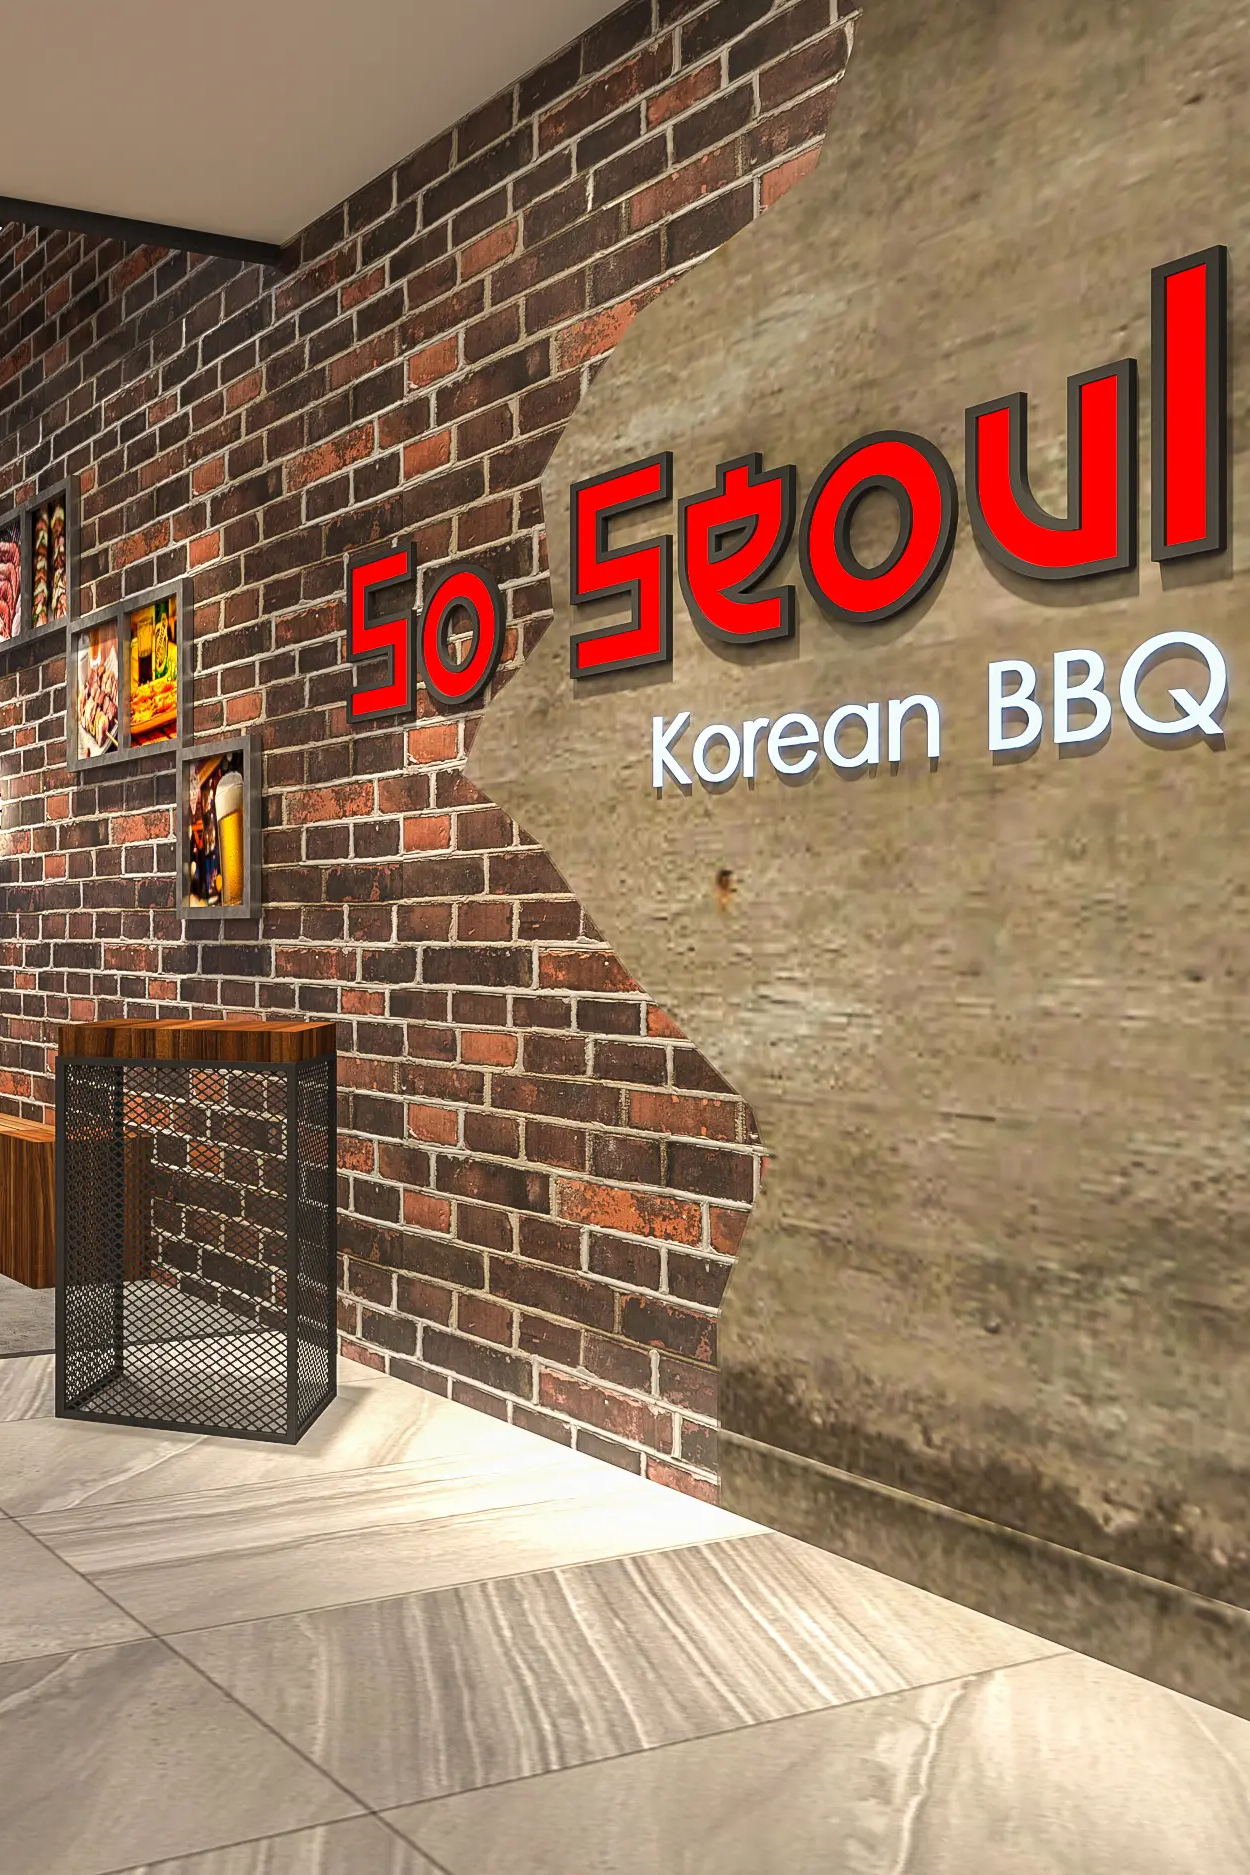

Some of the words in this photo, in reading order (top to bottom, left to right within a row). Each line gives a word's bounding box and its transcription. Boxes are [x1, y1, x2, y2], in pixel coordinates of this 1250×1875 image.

[347, 541, 506, 722] So
[570, 244, 1229, 680] Seoul
[652, 692, 942, 789] Korean
[987, 629, 1229, 753] BBQ
